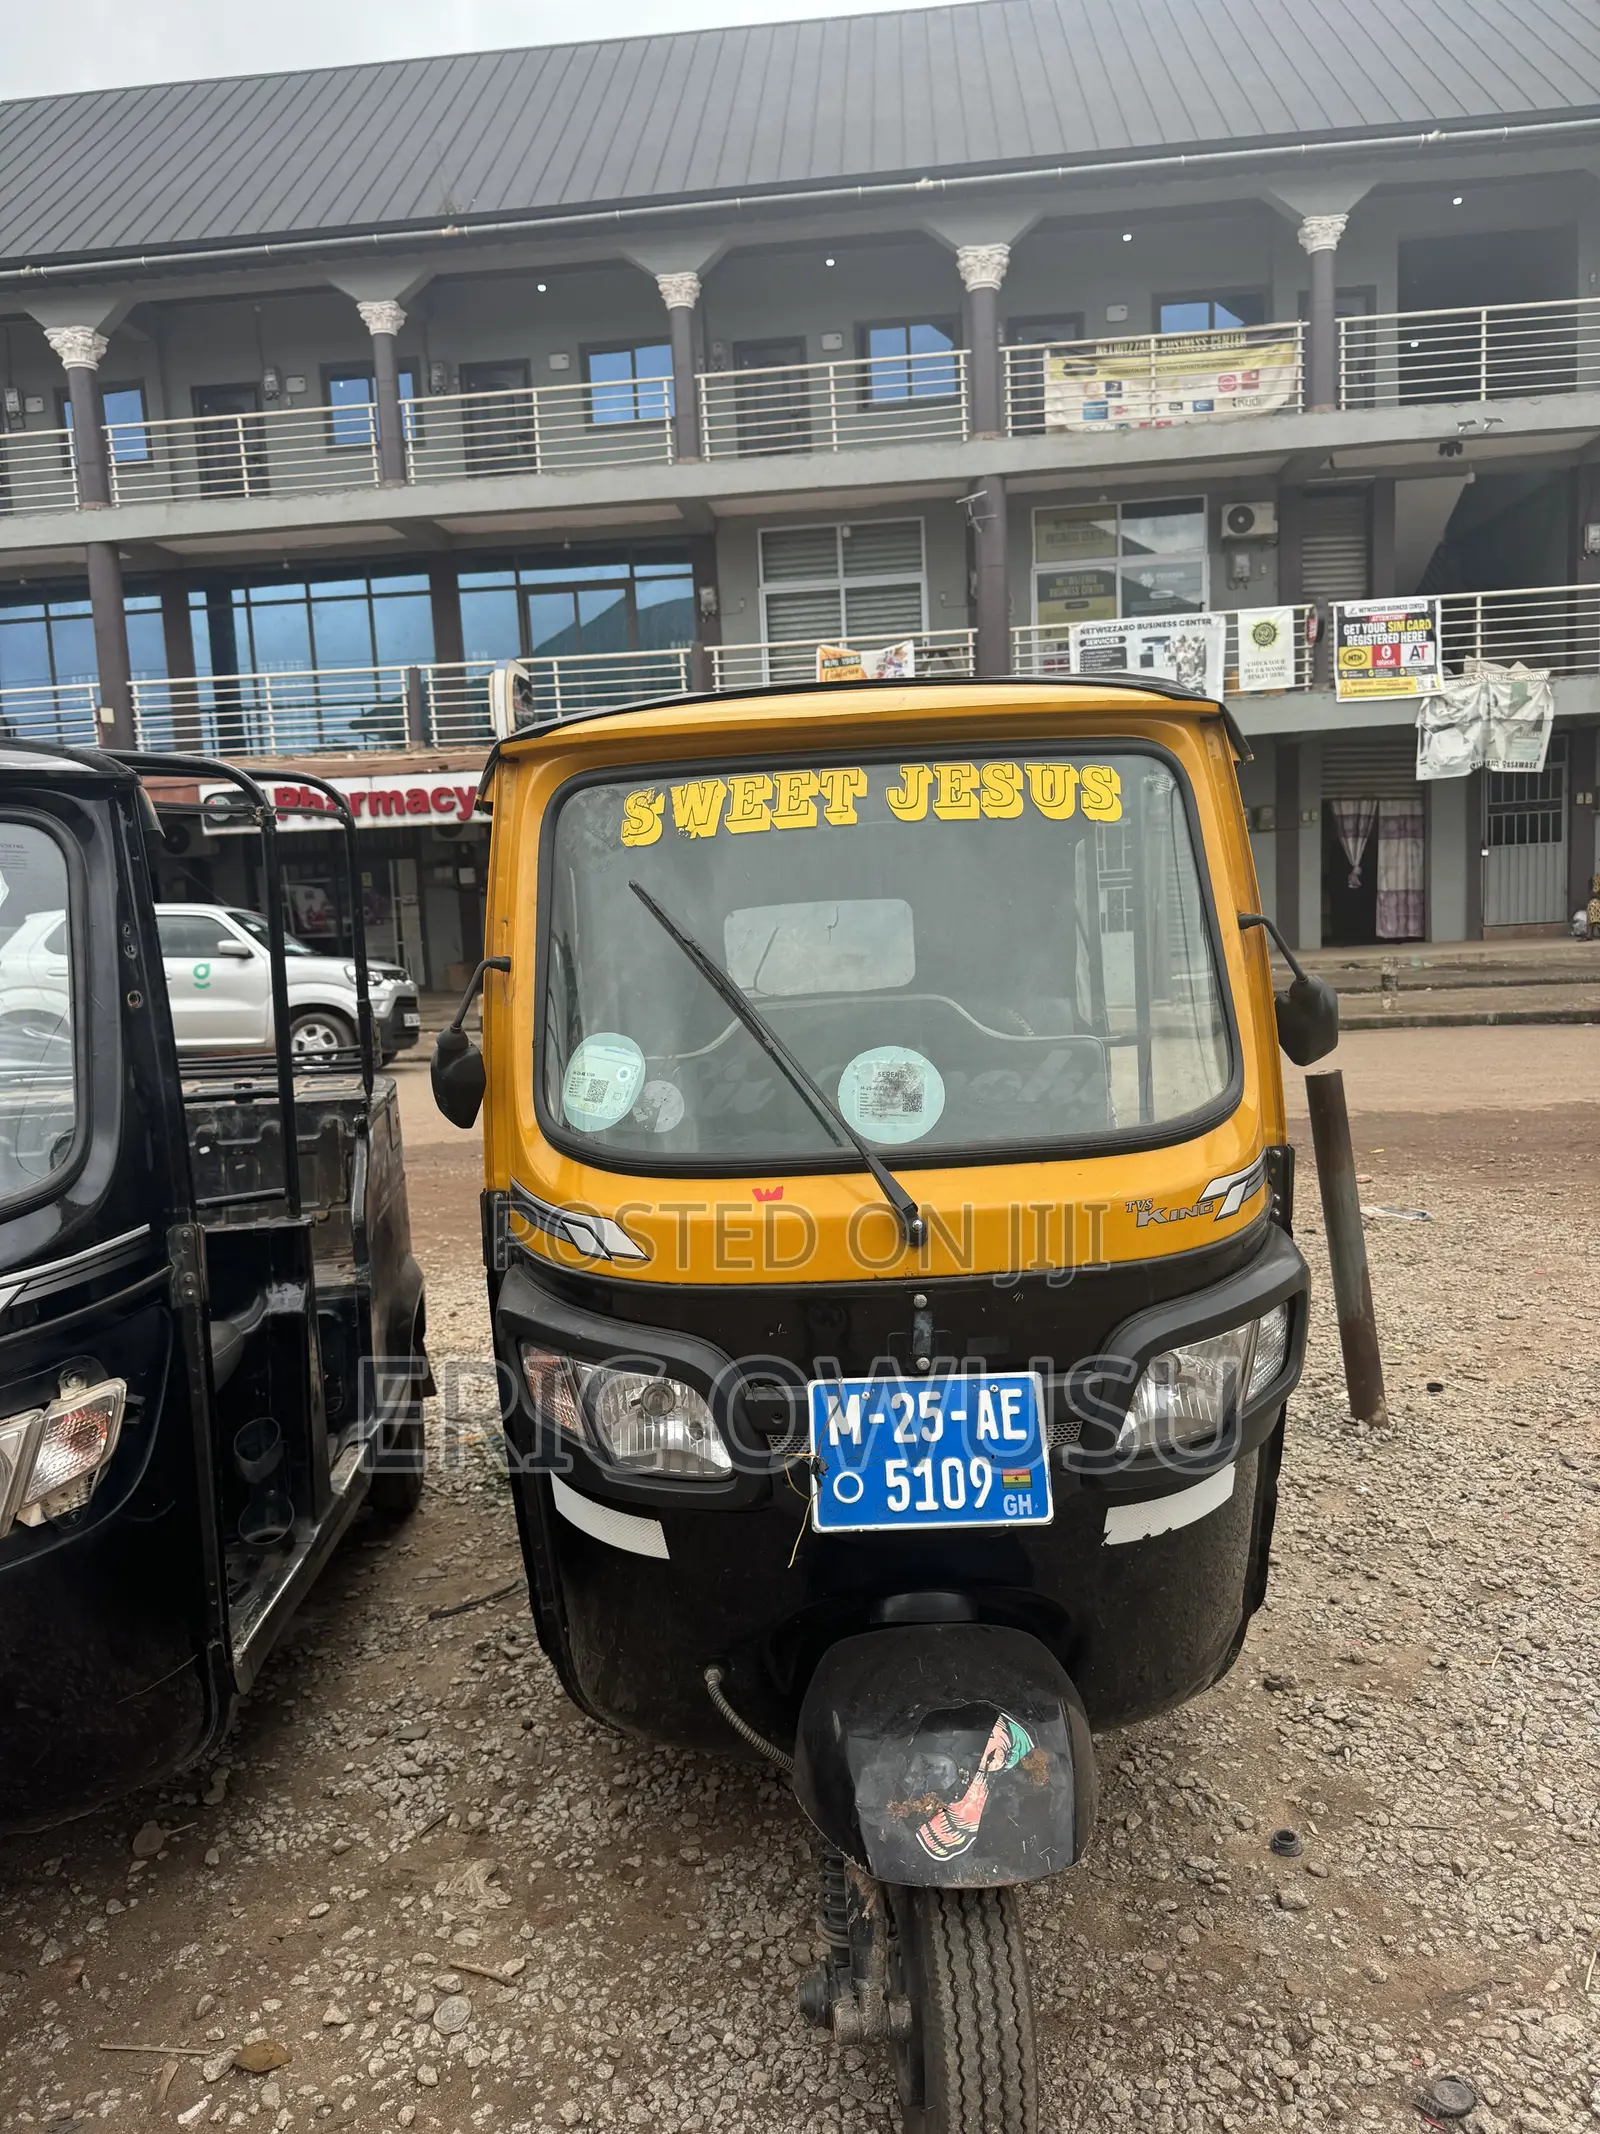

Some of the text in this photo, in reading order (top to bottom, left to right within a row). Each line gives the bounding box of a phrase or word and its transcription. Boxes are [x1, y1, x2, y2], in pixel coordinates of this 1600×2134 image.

[1079, 617, 1212, 636] NETWIZZARD BUSINESS CENTER
[1343, 619, 1432, 636] GET YOUR SIM CARD
[1085, 637, 1119, 646] SERVICES
[1346, 631, 1427, 646] REGISTERED HERE!
[1347, 654, 1362, 662] MTN
[1410, 644, 1428, 661] AT
[273, 785, 479, 823] Pharmacy
[620, 761, 1123, 847] SWEET JESUS
[1125, 1198, 1154, 1213] TVS
[1136, 1201, 1214, 1227] KING
[827, 1388, 1028, 1447] M-25-AE
[885, 1456, 993, 1513] 5109
[1002, 1494, 1033, 1516] GH
